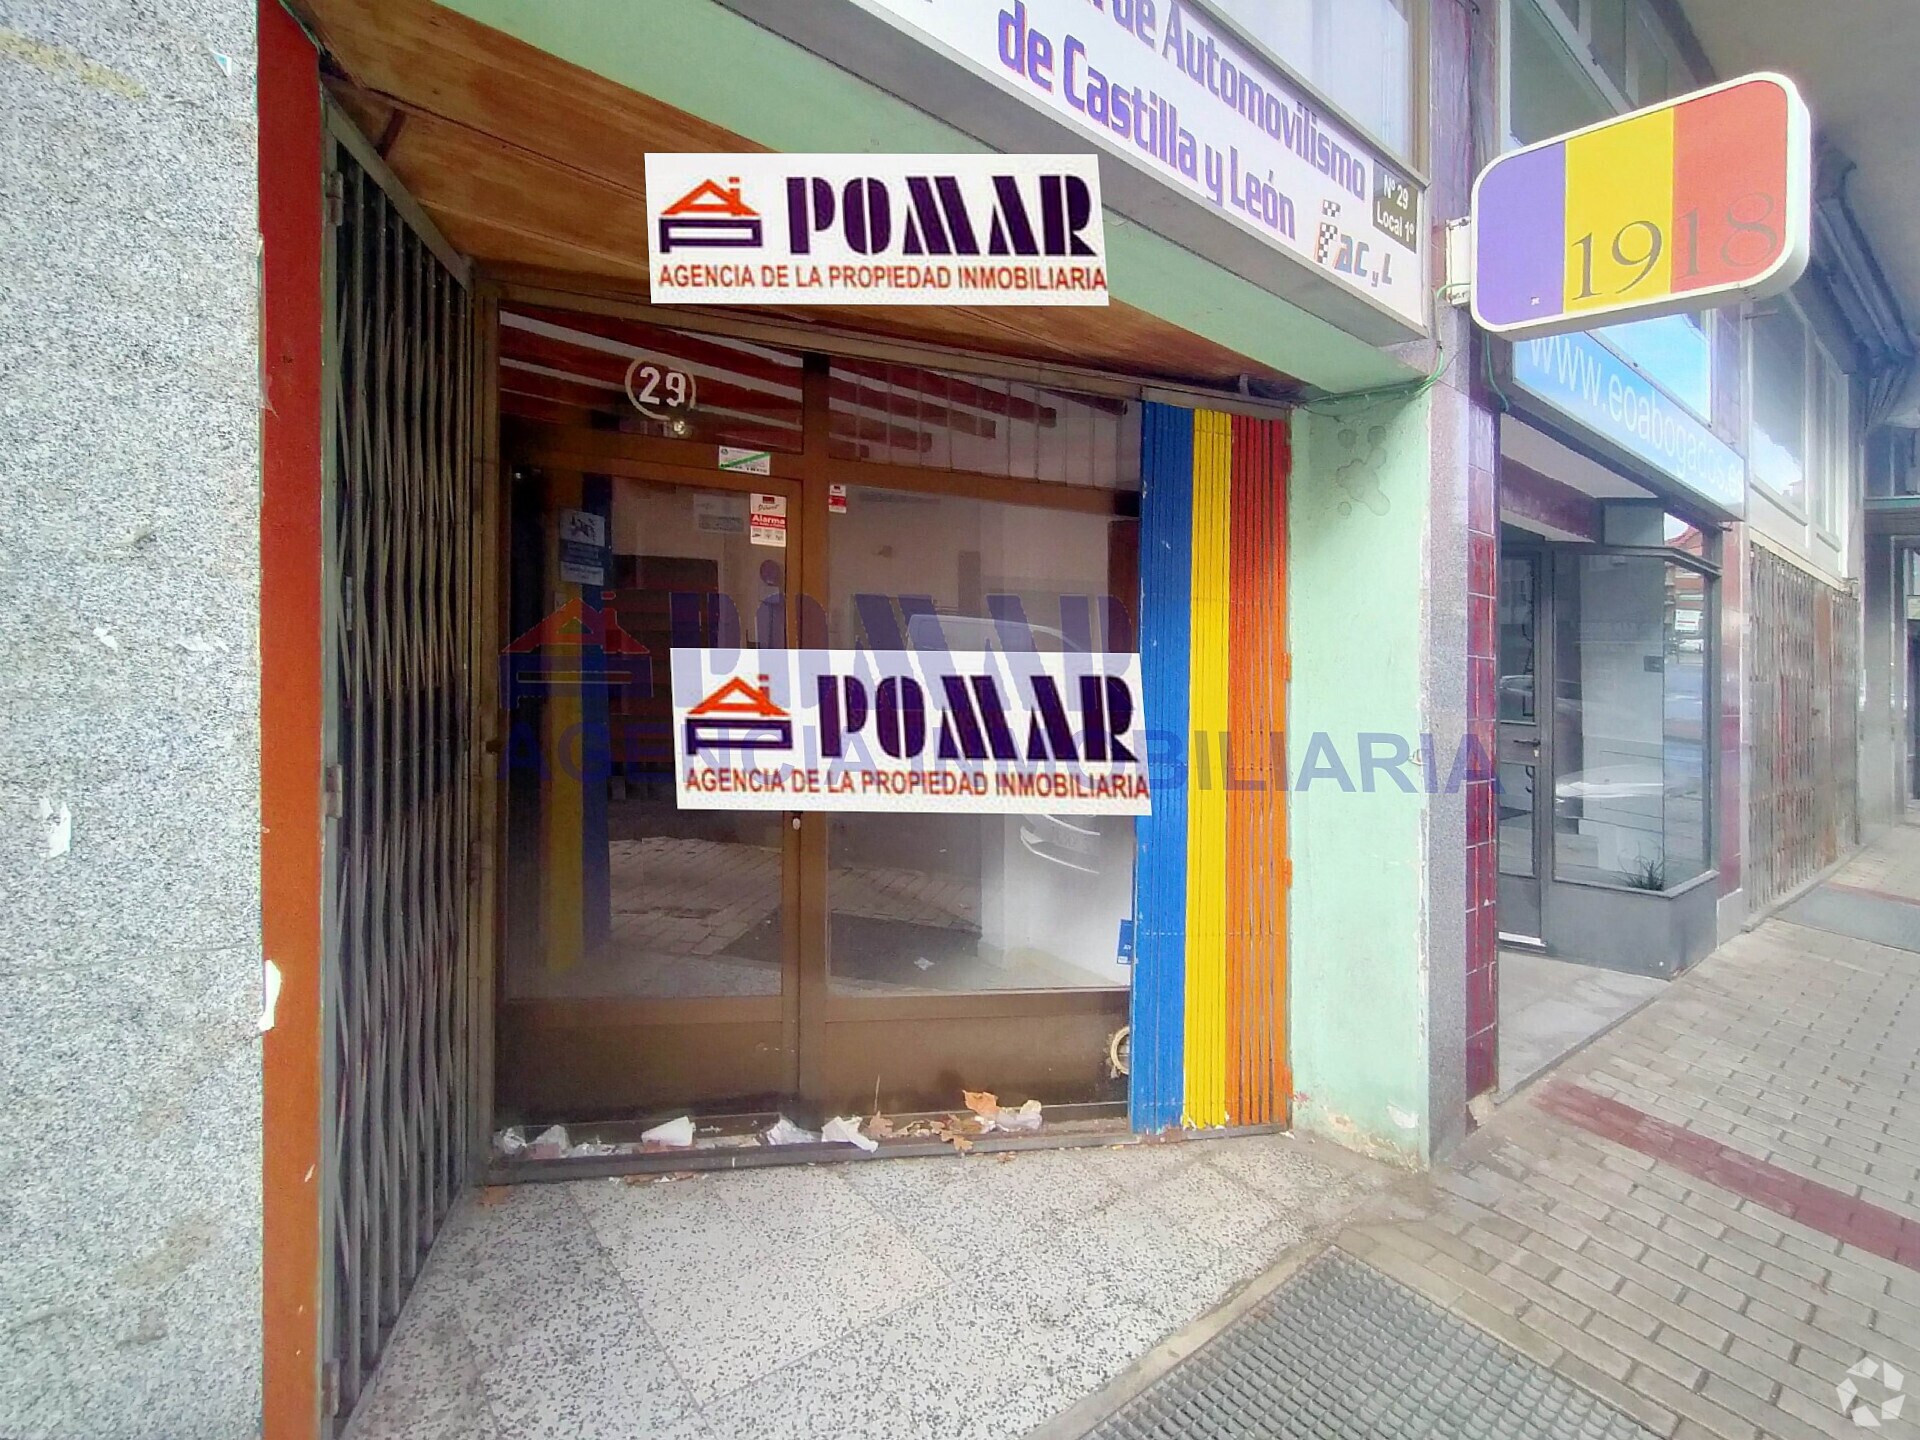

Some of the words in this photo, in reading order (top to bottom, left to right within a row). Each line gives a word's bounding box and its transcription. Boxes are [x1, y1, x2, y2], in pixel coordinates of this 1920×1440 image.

[998, 0, 1054, 94] de
[1063, 34, 1198, 183] Castilla
[1205, 145, 1223, 208] y
[1230, 146, 1296, 241] León
[1161, 0, 1365, 201] Automovilismo
[1396, 184, 1409, 210] 29
[1377, 200, 1403, 238] Local
[1571, 192, 1778, 300] 1918
[638, 366, 687, 408] 29
[752, 514, 786, 524] Alarma
